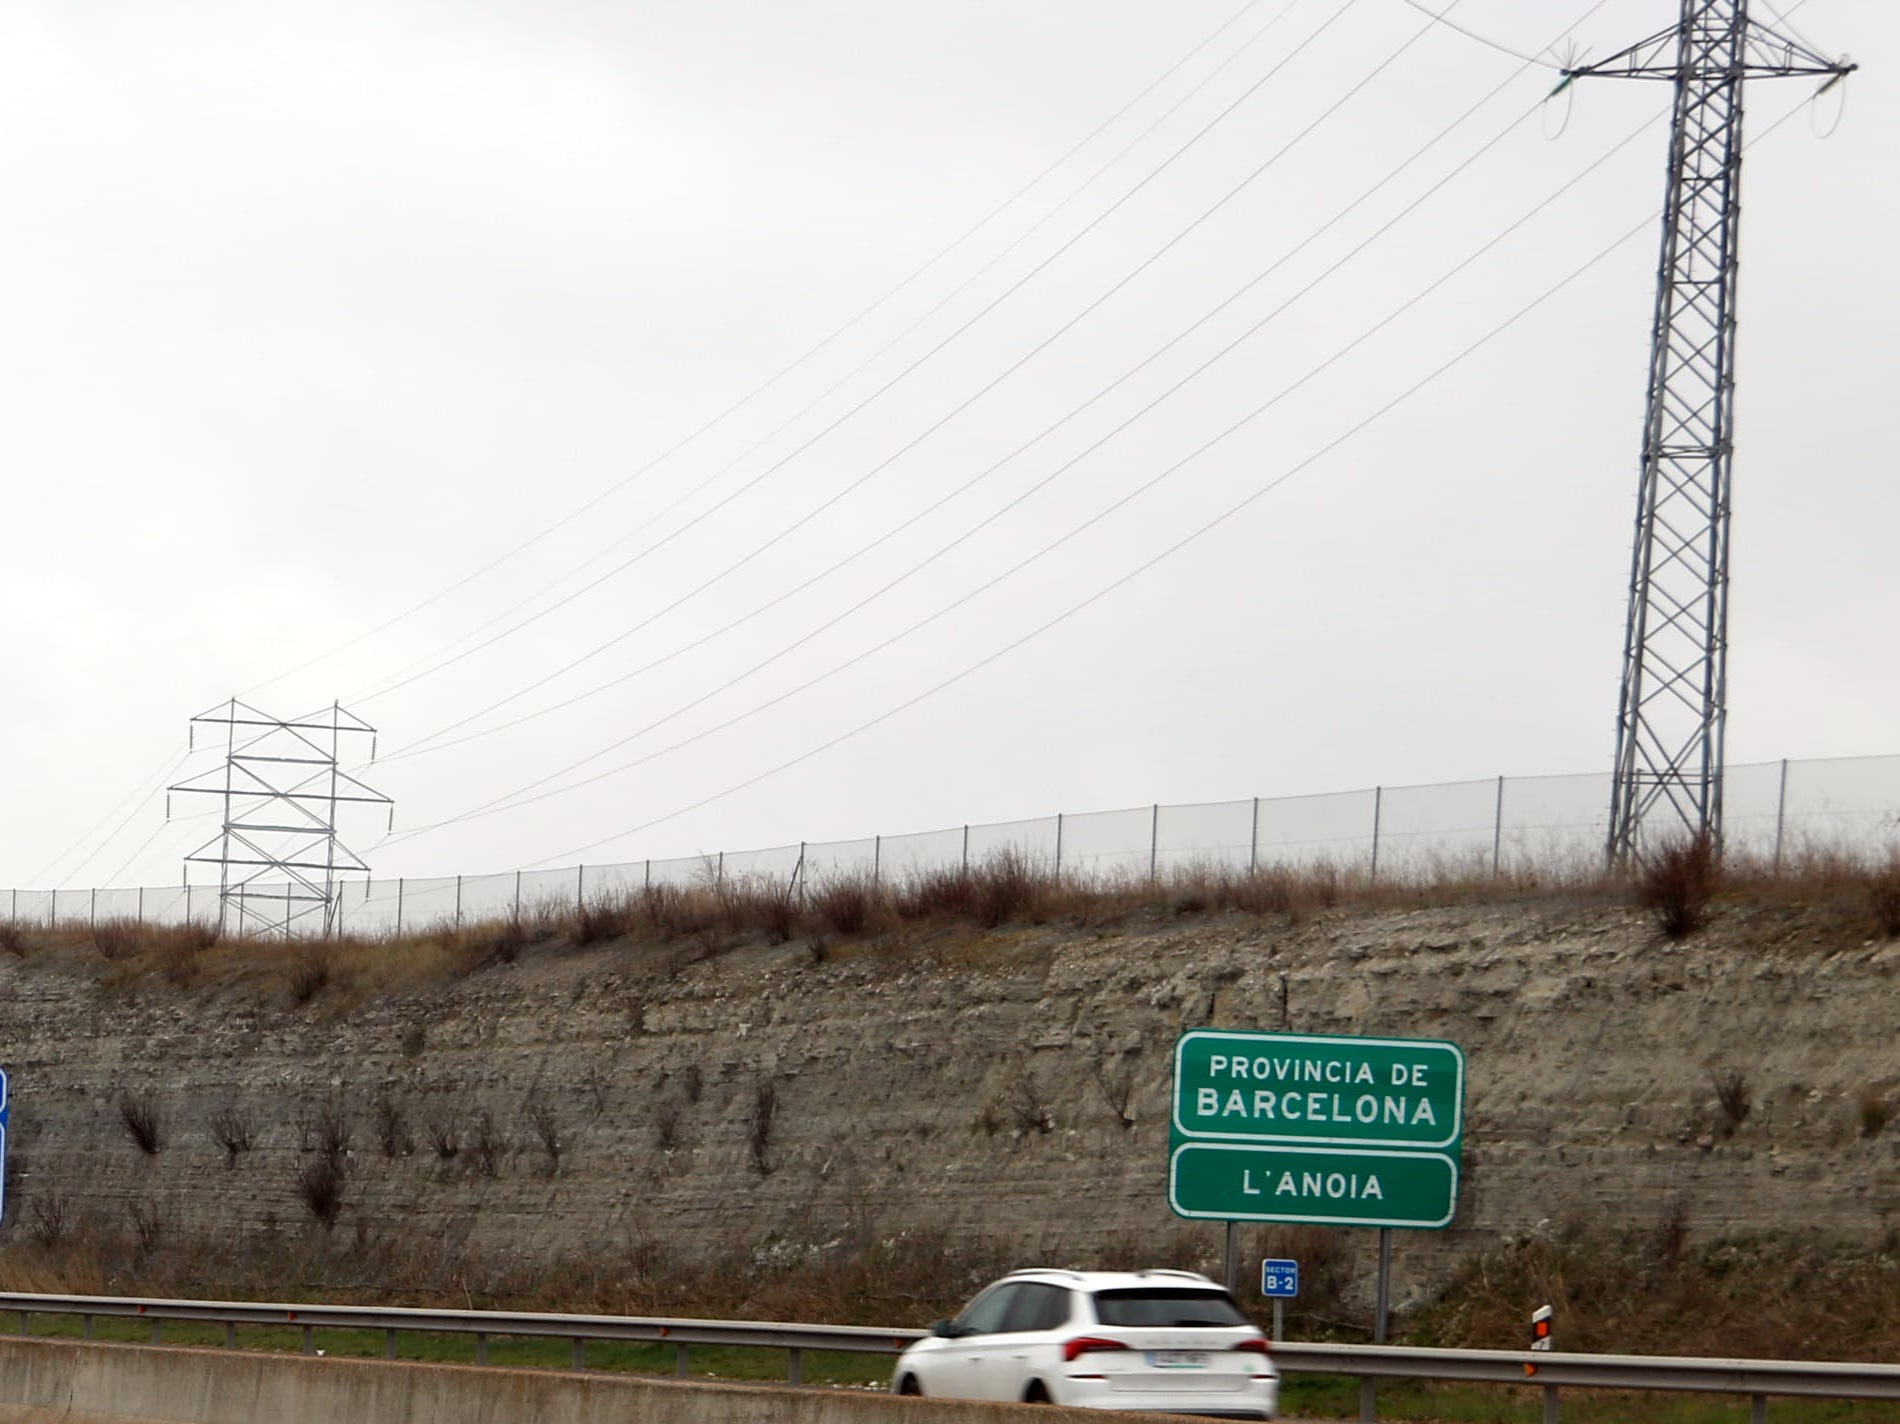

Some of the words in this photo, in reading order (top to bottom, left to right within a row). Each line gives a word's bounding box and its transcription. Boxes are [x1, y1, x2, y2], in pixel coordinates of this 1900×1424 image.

[1209, 1055, 1374, 1085] PROVINCIA
[1391, 1064, 1429, 1086] DE
[1196, 1087, 1437, 1126] BARCELONA
[1242, 1168, 1384, 1200] L'ANOIA
[1265, 1265, 1296, 1274] SECTOR
[1266, 1275, 1294, 1290] B-2
